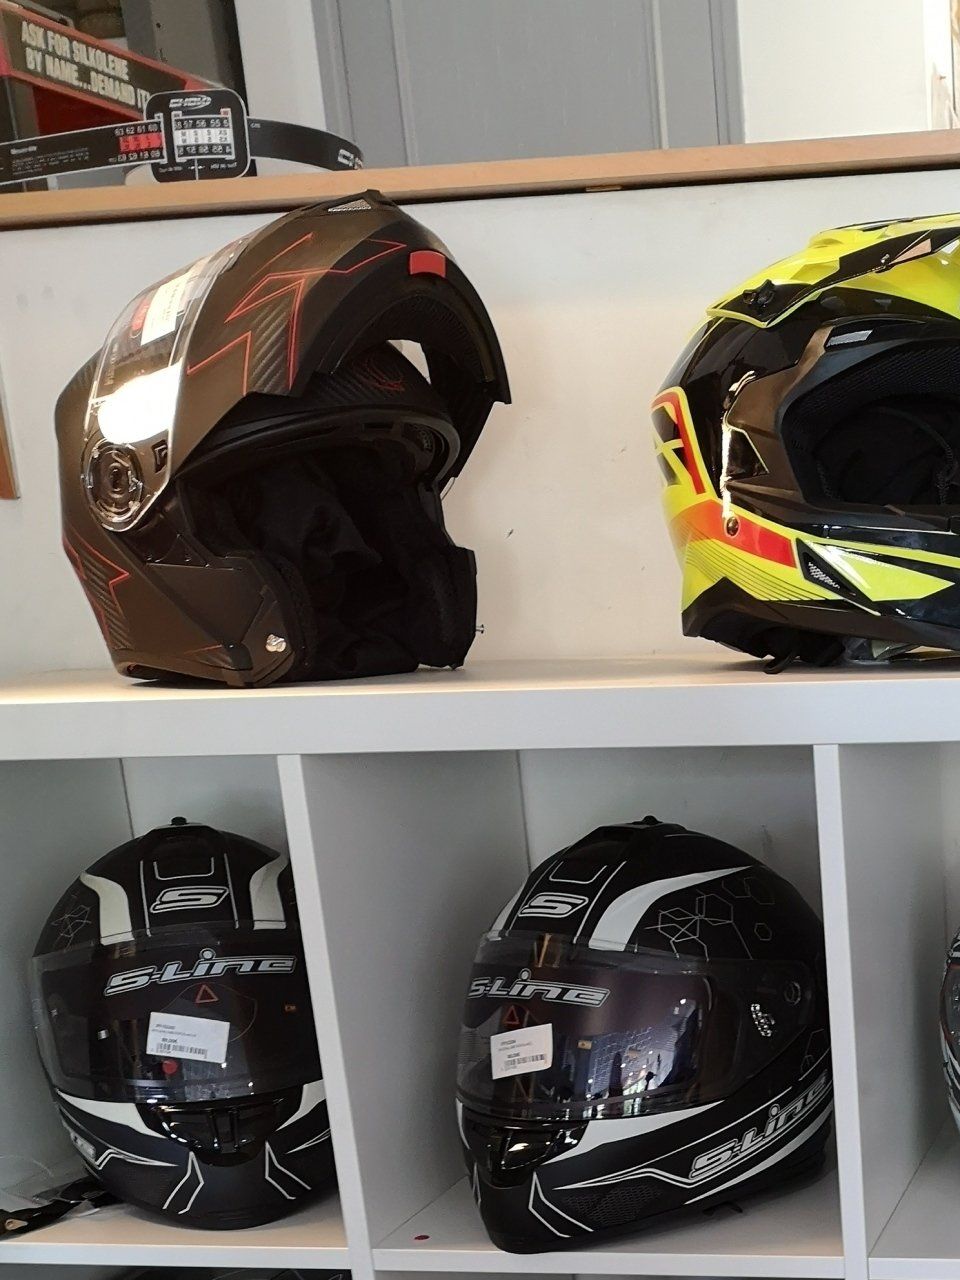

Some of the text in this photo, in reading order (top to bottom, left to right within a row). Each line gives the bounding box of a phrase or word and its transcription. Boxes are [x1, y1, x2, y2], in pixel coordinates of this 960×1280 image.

[21, 20, 129, 81] ASK FOR SILKOLENE
[25, 47, 42, 73] BY
[125, 127, 135, 135] 62
[195, 120, 207, 128] 56
[209, 120, 221, 128] 55
